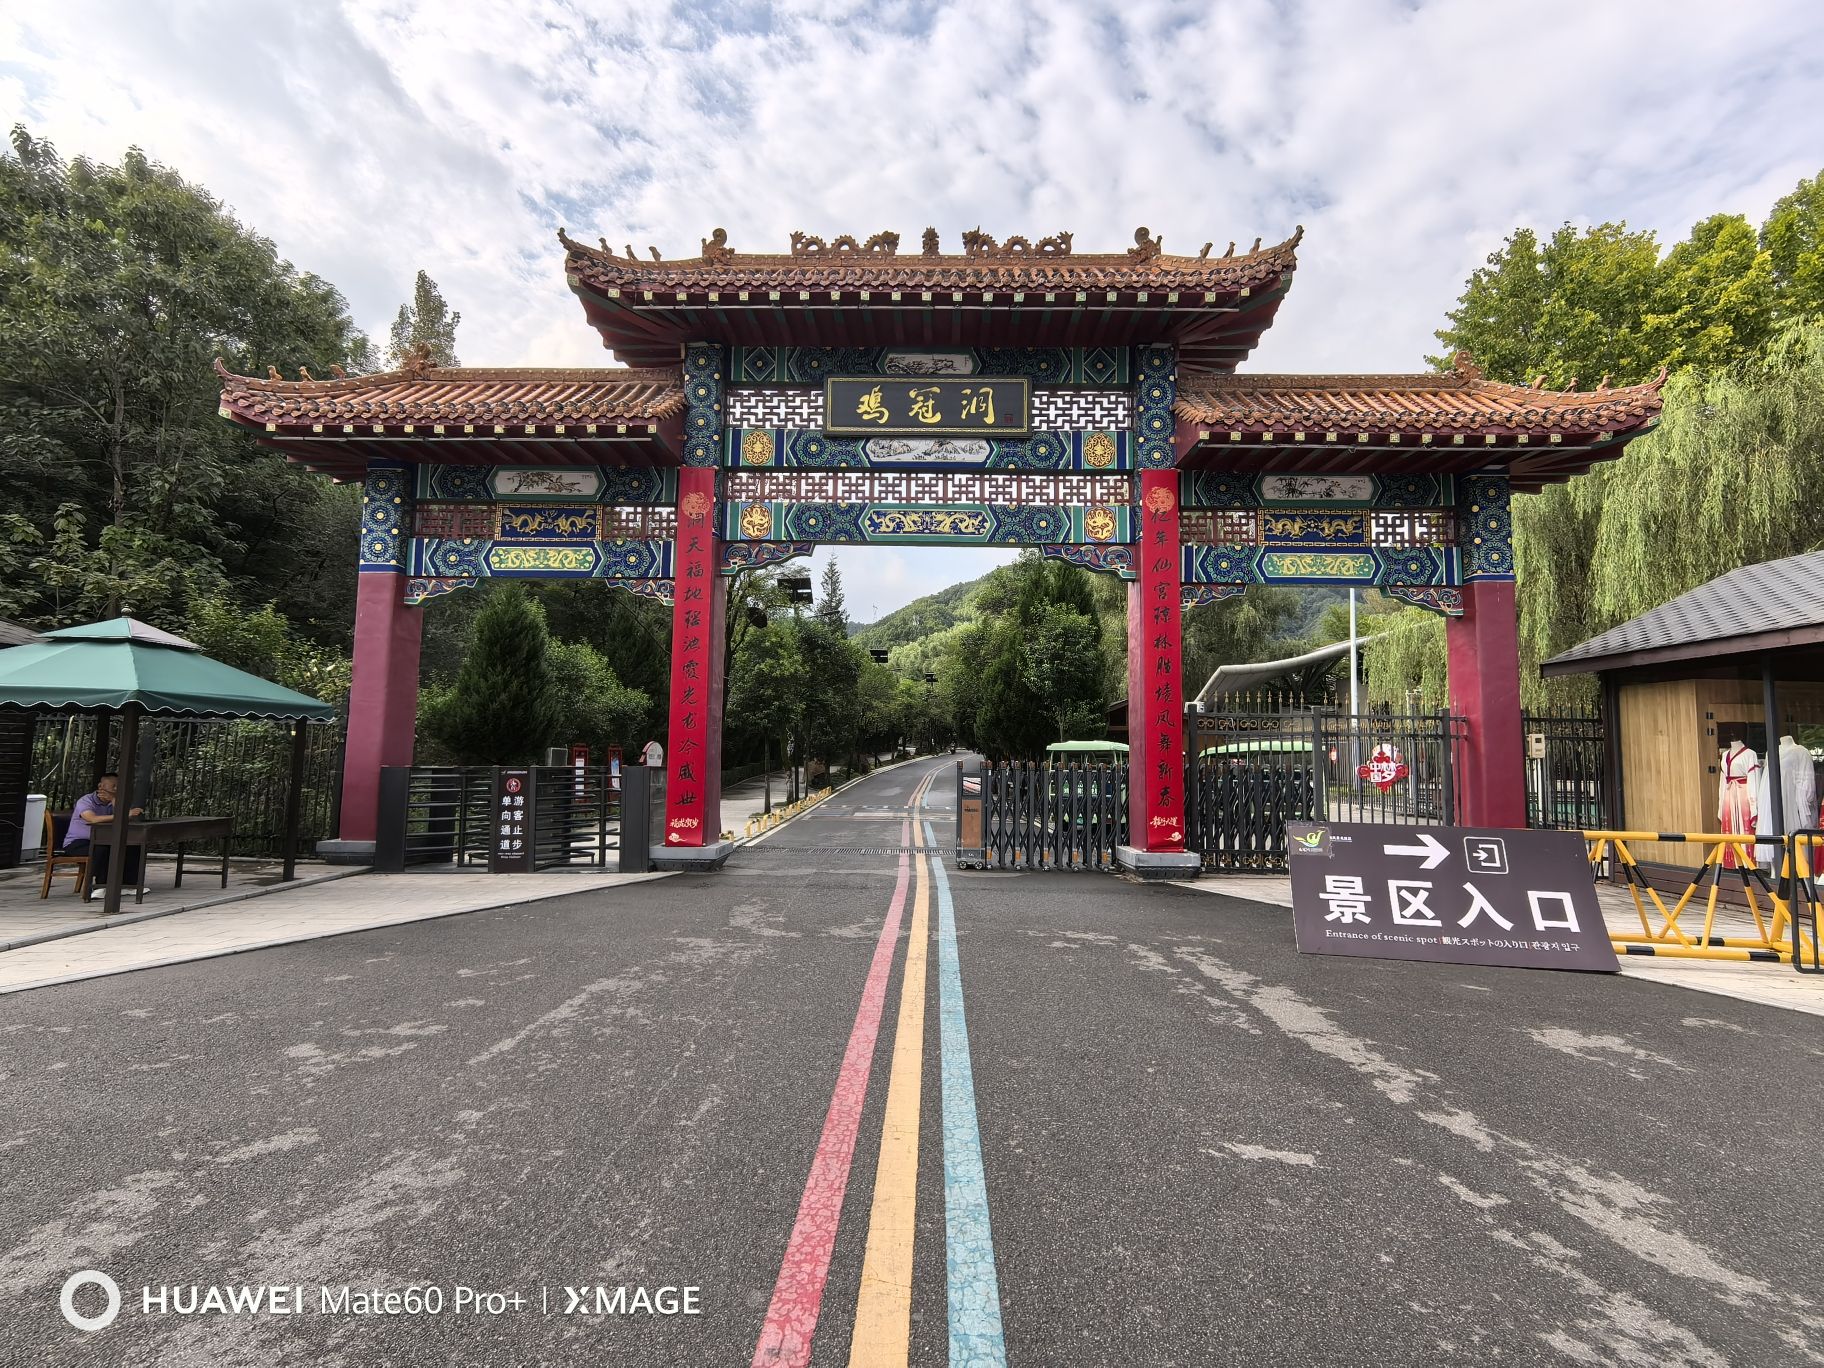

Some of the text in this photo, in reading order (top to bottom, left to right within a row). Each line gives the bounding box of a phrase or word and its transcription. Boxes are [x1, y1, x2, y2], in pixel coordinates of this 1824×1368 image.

[856, 384, 995, 425] 鸡冠洞
[500, 796, 512, 850] 单向通道
[512, 796, 524, 850] 游客止步
[1319, 875, 1581, 932] 景区入口
[1325, 929, 1369, 940] Entrance
[1383, 934, 1414, 943] scenic
[1416, 936, 1439, 945] spot
